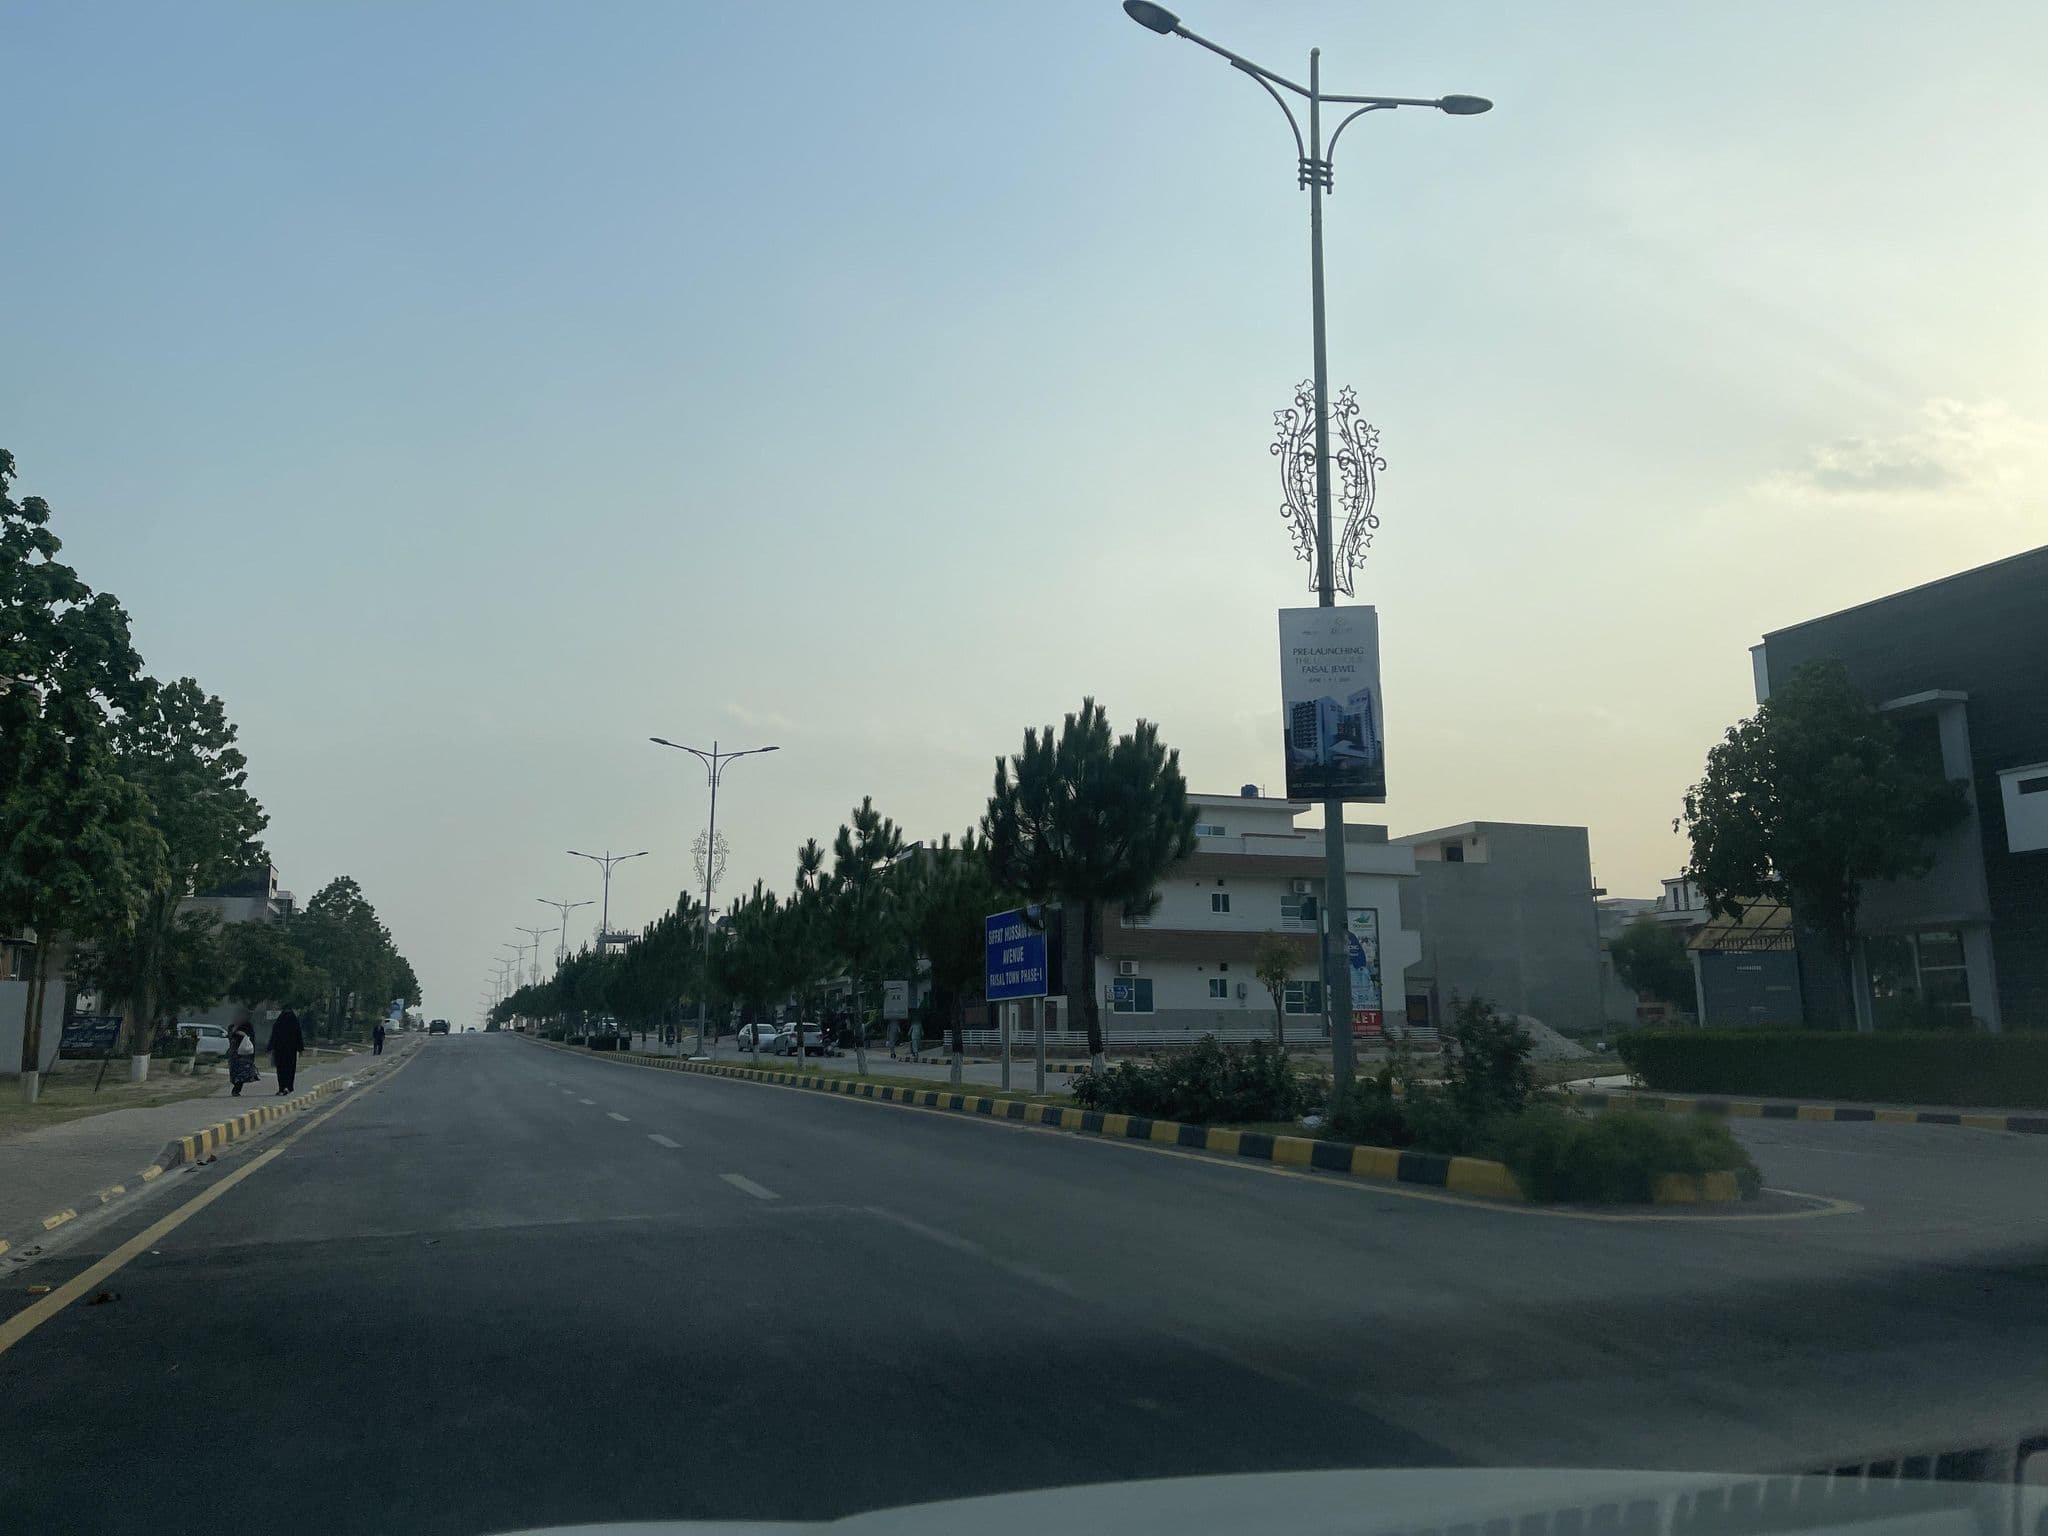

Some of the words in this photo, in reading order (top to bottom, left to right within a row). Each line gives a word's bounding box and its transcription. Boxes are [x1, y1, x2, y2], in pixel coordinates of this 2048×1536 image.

[1302, 665, 1328, 673] FAISAL
[1003, 946, 1024, 964] AVENUE
[990, 973, 1005, 986] FAISAL
[1006, 971, 1020, 984] TOWN
